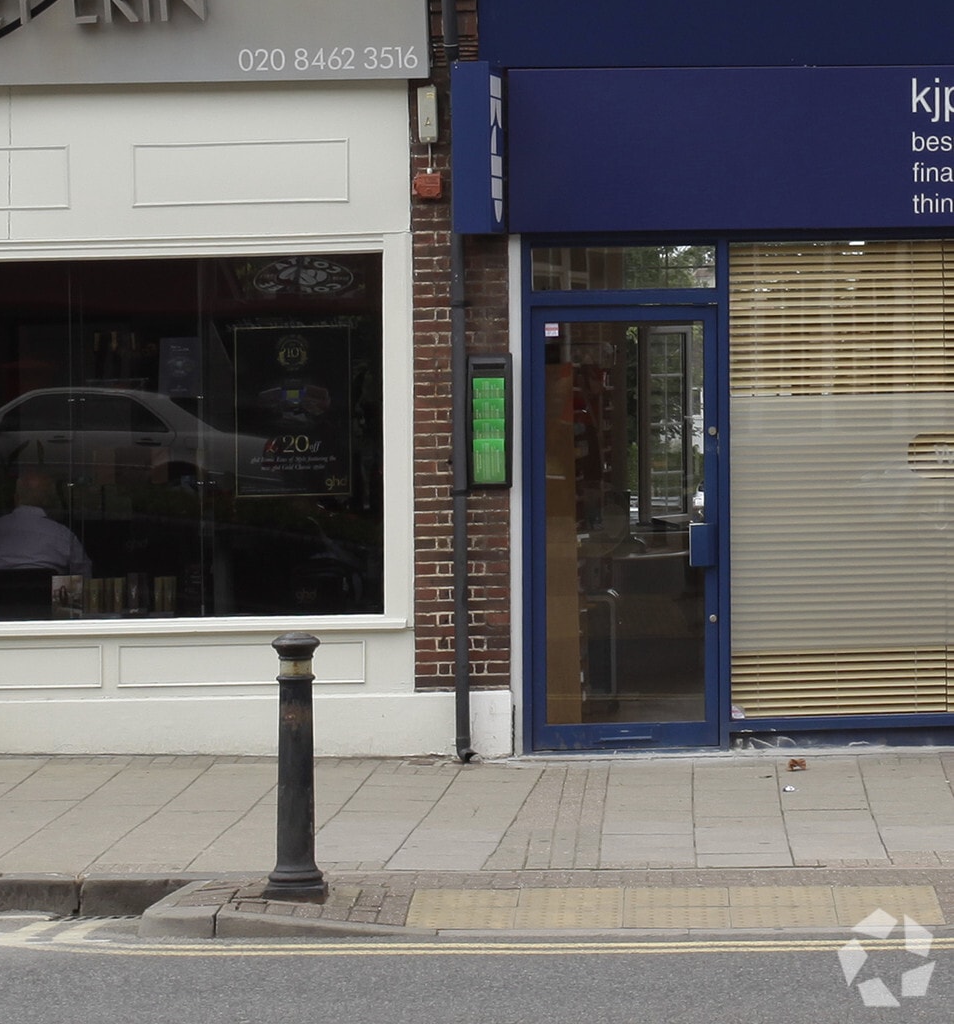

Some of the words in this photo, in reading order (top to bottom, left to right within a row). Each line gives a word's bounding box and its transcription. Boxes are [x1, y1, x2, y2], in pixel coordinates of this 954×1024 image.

[238, 48, 285, 72] 020
[294, 47, 355, 71] 8462
[363, 46, 418, 70] 3516
[911, 131, 954, 152] bes
[912, 161, 954, 183] fina
[912, 193, 954, 214] thin
